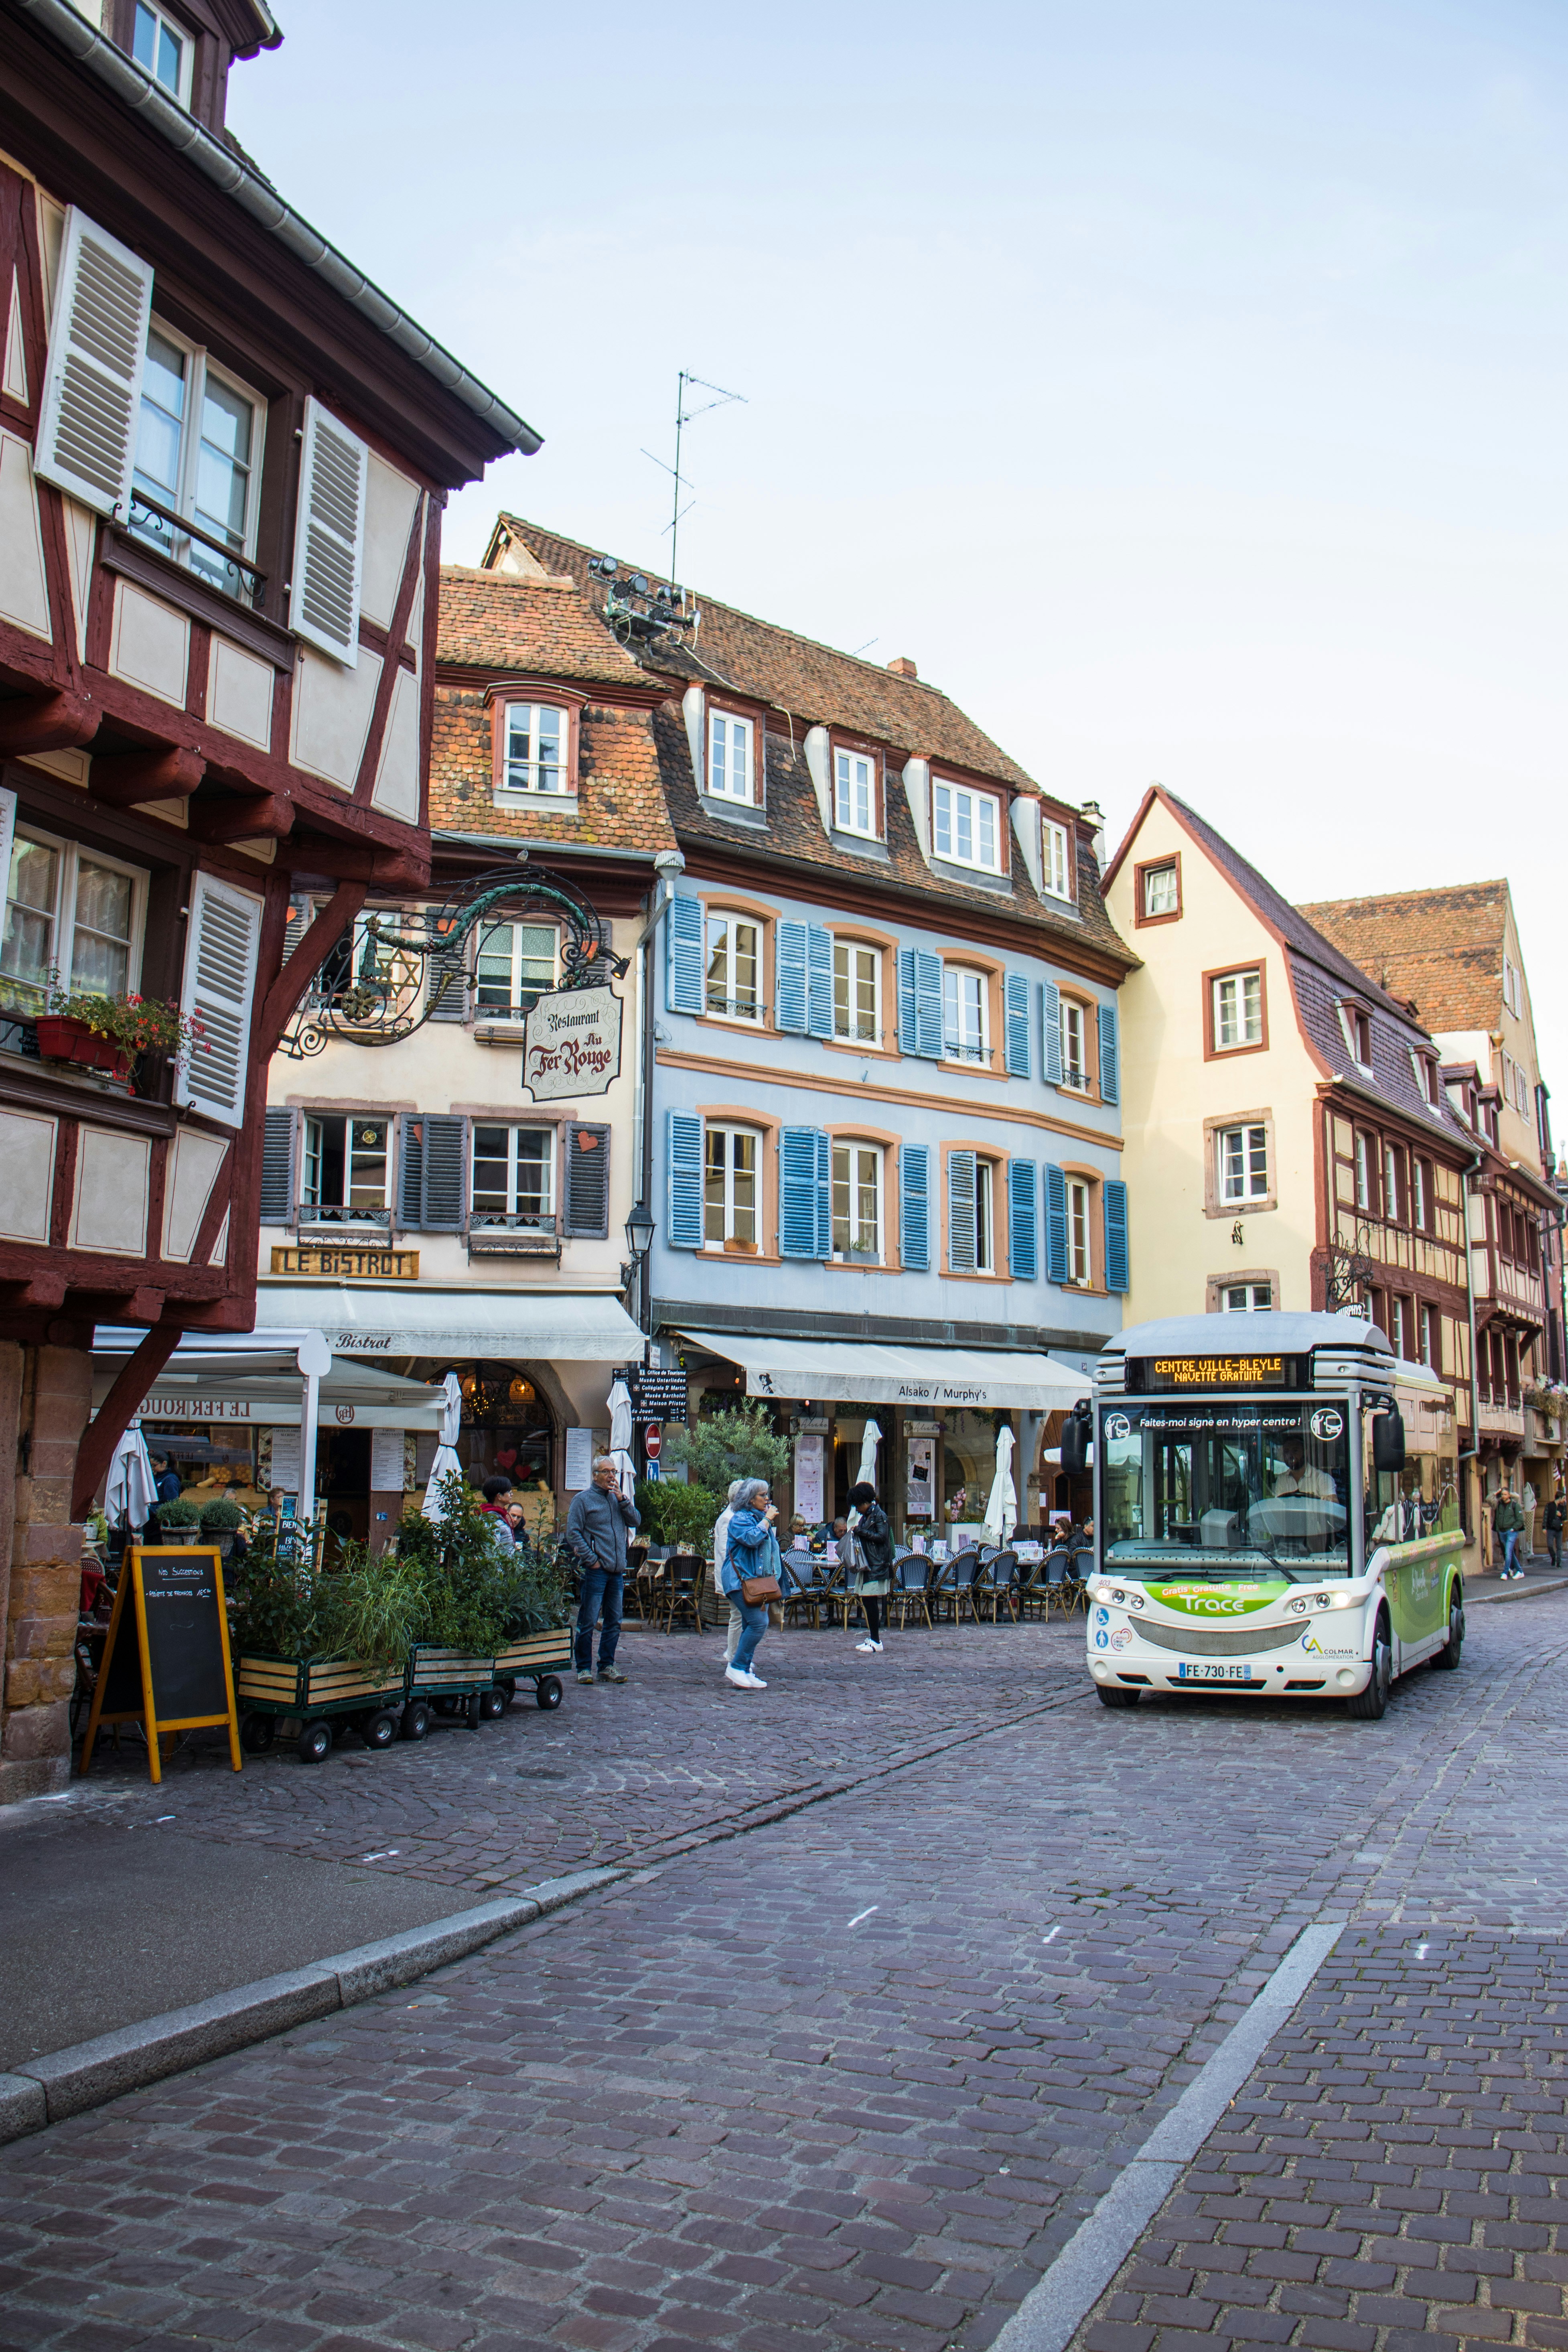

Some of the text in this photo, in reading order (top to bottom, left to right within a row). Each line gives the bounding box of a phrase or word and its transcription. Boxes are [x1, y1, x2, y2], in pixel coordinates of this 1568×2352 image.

[548, 1009, 599, 1033] Restaurant
[584, 1033, 602, 1046] Au
[529, 1037, 613, 1083] Fer Rouge
[284, 1250, 310, 1272] LE
[335, 1333, 391, 1349] Bistrot
[1155, 1359, 1281, 1373] CENTRE VILLE-BLEYLE
[1174, 1370, 1263, 1382] NAVETTE GRATUITE
[899, 1386, 929, 1397] Alsako
[944, 1388, 987, 1401] Murphy's
[1140, 1418, 1186, 1427] Faites-moi
[1189, 1418, 1214, 1428] signe
[1231, 1417, 1260, 1428] hyper
[1263, 1418, 1296, 1426] centre
[1162, 1585, 1188, 1596] Gratis
[1193, 1583, 1230, 1593] Gratuite
[1179, 1595, 1245, 1612] Trace
[1187, 1665, 1243, 1678] FE-730-FE
